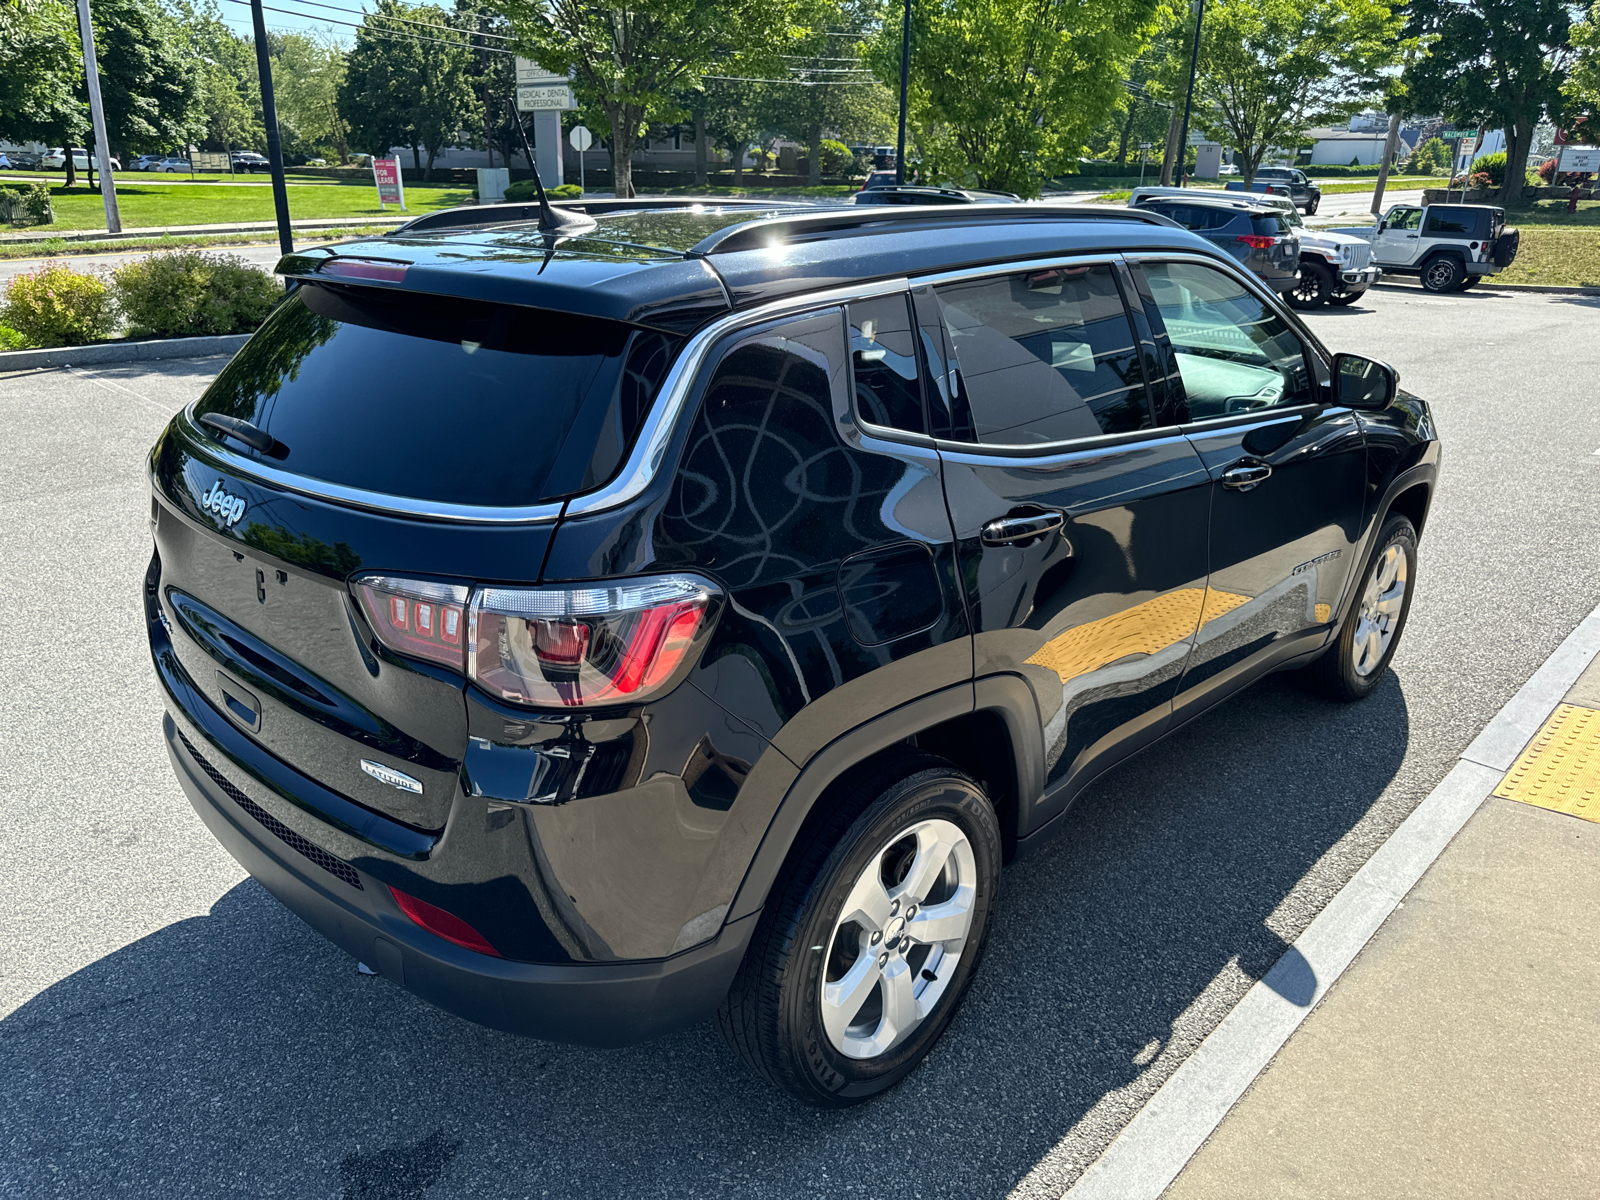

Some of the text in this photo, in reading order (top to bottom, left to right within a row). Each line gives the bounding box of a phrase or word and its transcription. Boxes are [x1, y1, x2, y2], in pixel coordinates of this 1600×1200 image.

[526, 70, 544, 78] OFFICE
[518, 89, 568, 98] MEDICAL DENTAL
[523, 99, 563, 108] PROFESSIONAL
[376, 169, 388, 177] FOR
[377, 176, 395, 184] LEASE
[202, 479, 246, 527] Jeep
[365, 764, 415, 789] LATITUDE
